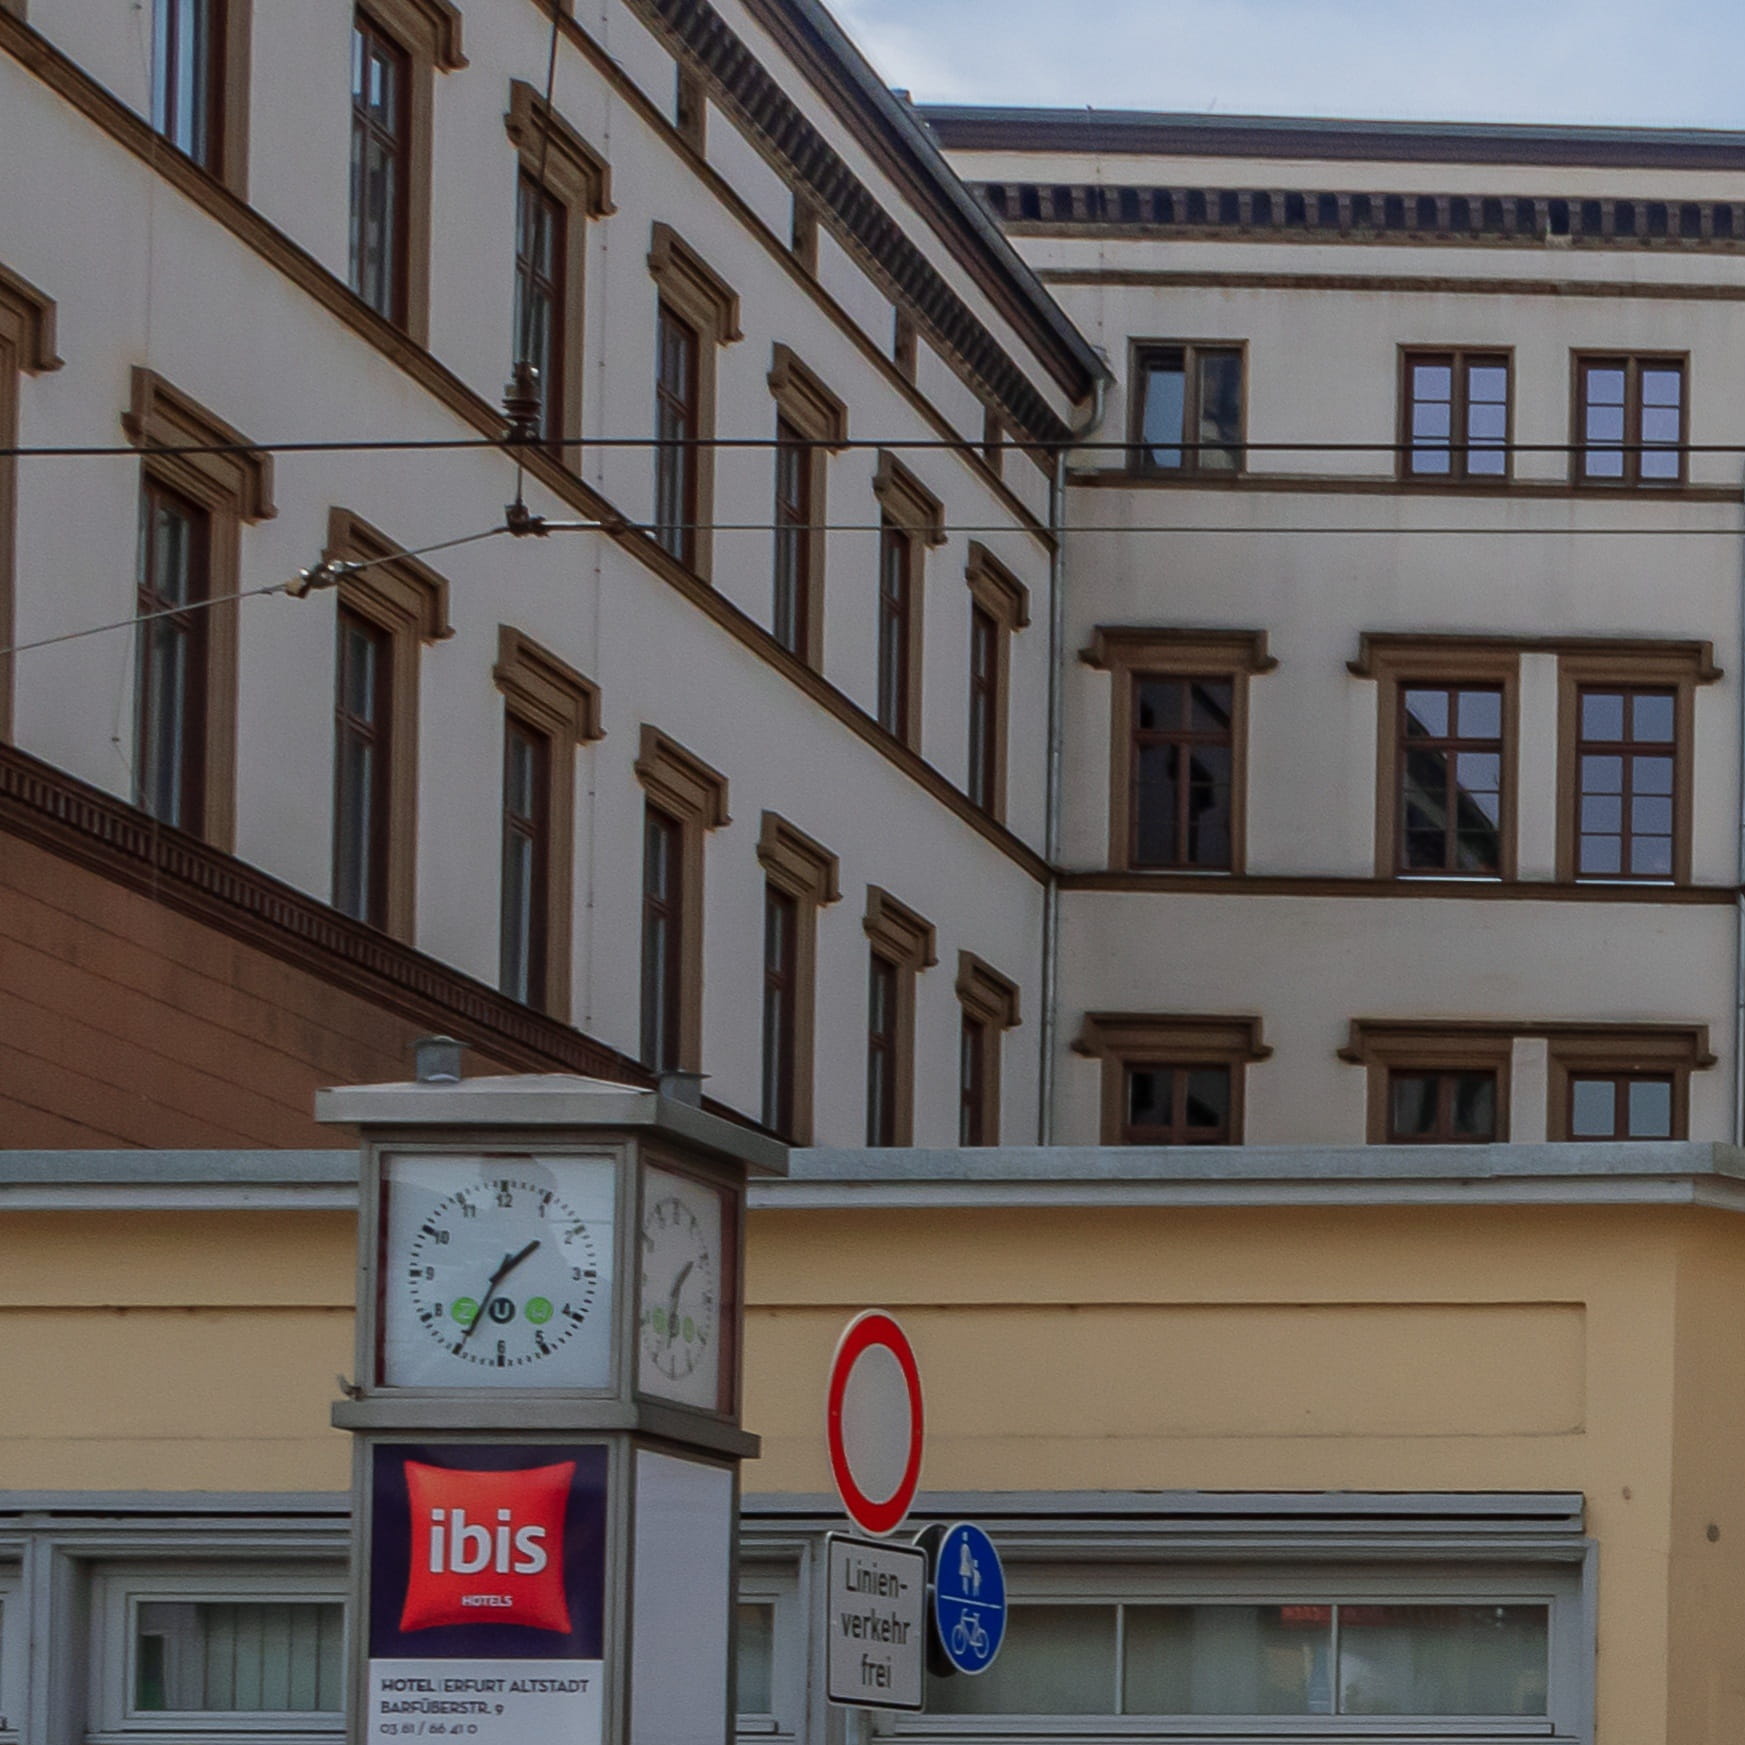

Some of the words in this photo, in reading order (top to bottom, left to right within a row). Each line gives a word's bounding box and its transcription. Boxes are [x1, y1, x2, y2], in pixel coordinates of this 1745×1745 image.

[496, 1194, 513, 1209] 12
[462, 1205, 477, 1219] 11
[538, 1205, 545, 1218] 1
[435, 1231, 450, 1245] 10
[425, 1266, 435, 1281] 9
[572, 1266, 582, 1281] 3
[435, 1302, 444, 1317] 8
[561, 1303, 572, 1316] 4
[535, 1330, 545, 1345] 5
[497, 1340, 506, 1354] 6
[429, 1508, 548, 1574] ibis
[846, 1558, 908, 1598] Linien-
[461, 1595, 513, 1607] HOTELS
[840, 1608, 911, 1645] verkehr
[860, 1653, 892, 1689] frei
[381, 1679, 434, 1693] HOTEL
[444, 1679, 506, 1693] ERFURT
[509, 1679, 590, 1693] ALTSTADT
